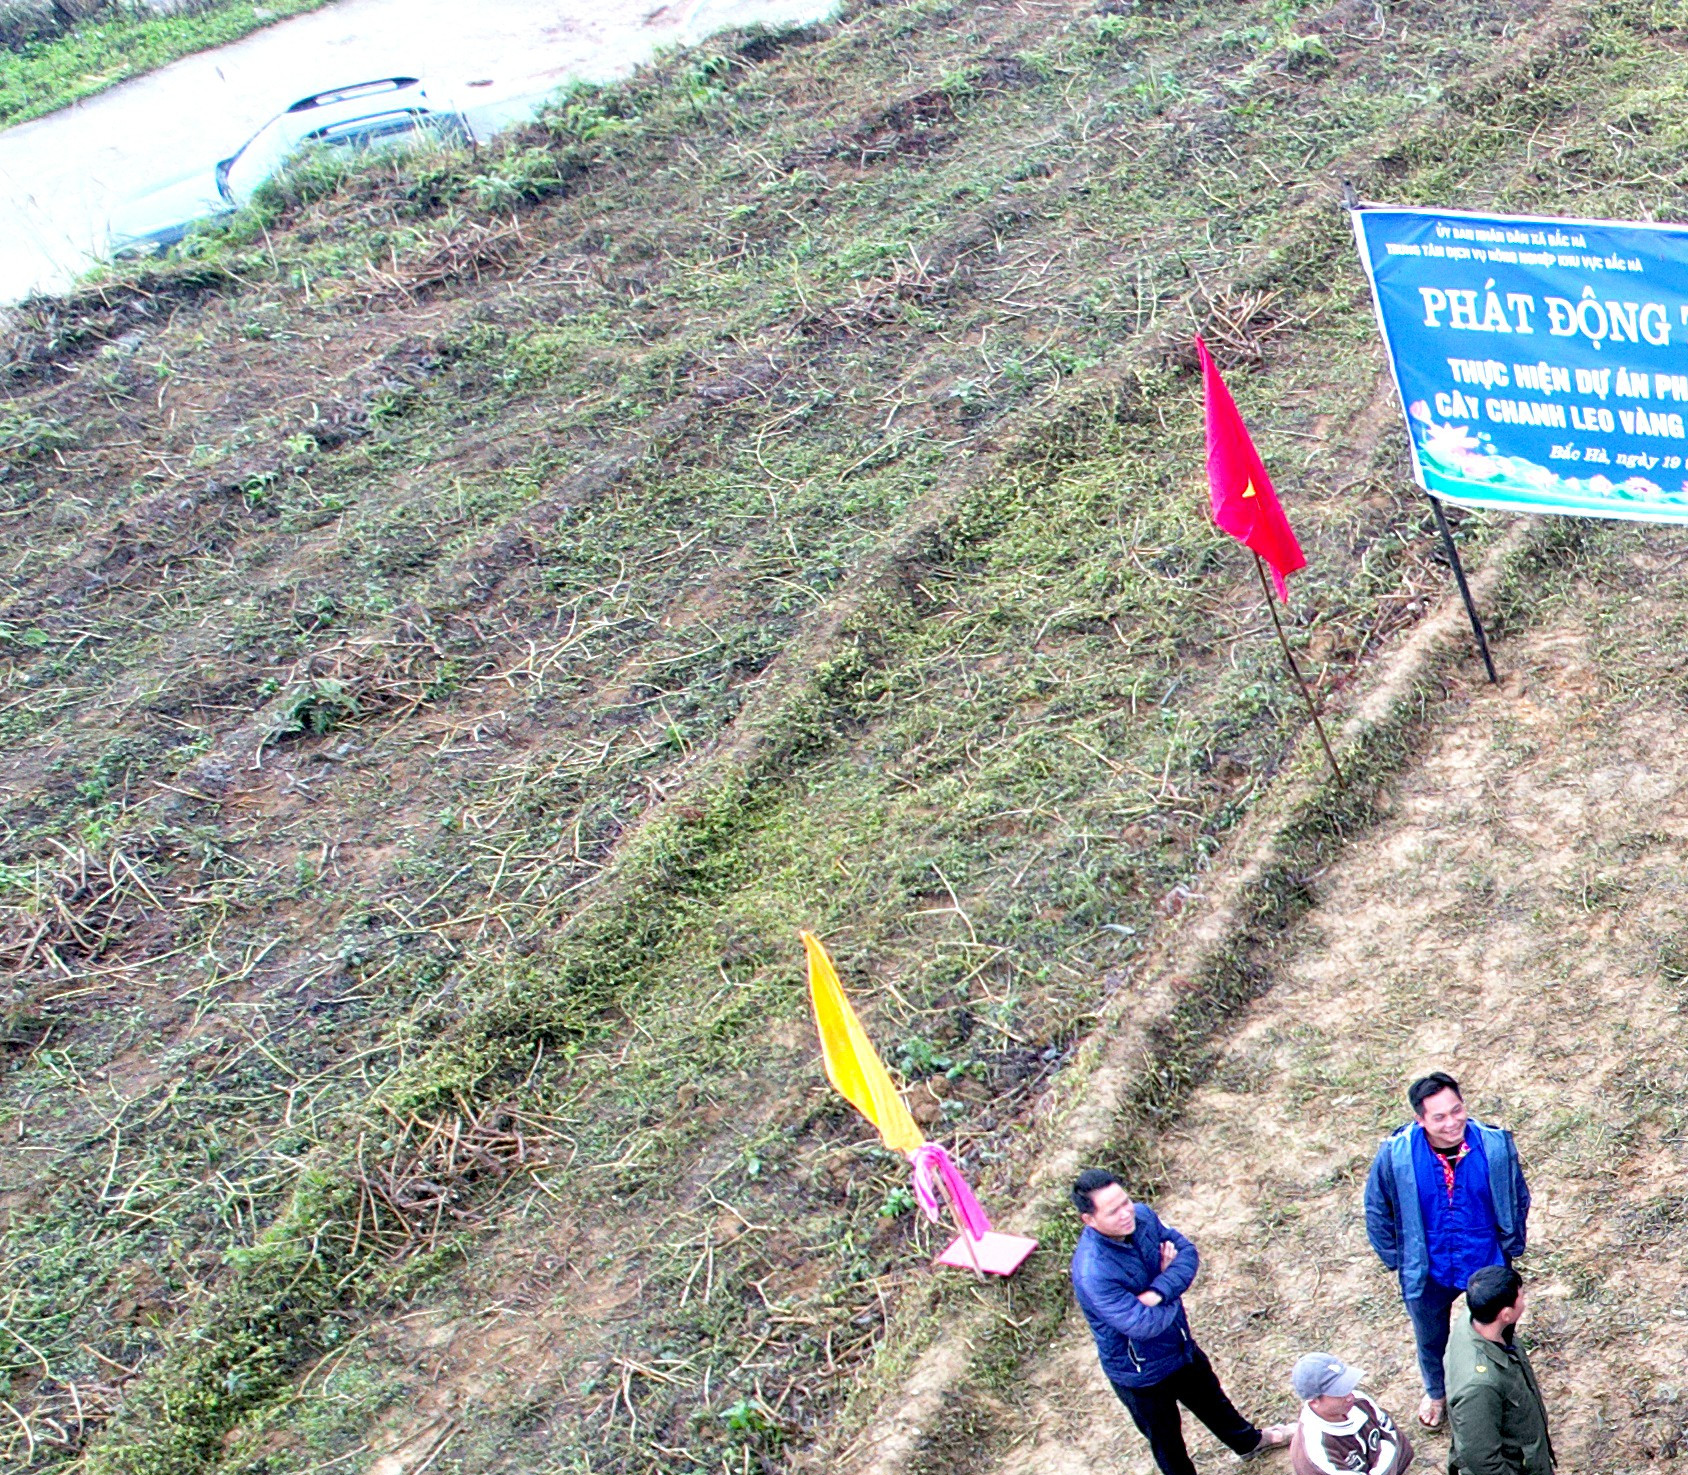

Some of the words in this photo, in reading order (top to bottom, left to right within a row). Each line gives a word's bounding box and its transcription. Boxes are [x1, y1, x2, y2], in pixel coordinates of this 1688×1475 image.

[1572, 233, 1586, 248] HÀ
[1472, 249, 1487, 263] VỤ
[1558, 255, 1580, 267] KHU
[1628, 257, 1643, 272] HÀ
[1418, 277, 1534, 334] PHÁT
[1544, 285, 1672, 350] ĐỘNG
[1447, 358, 1509, 390] THỰC
[1513, 361, 1570, 395] HIỆN
[1575, 367, 1611, 400] DỰ
[1615, 366, 1649, 398] ÁN
[1435, 390, 1479, 419] CÂY
[1485, 398, 1566, 428] CHANH
[1570, 405, 1614, 432] LEO
[1618, 407, 1685, 438] VÀNG
[1549, 442, 1580, 460] Bắc
[1584, 448, 1610, 464] Hà,
[1616, 452, 1659, 470] ngày
[1662, 456, 1681, 468] 19
